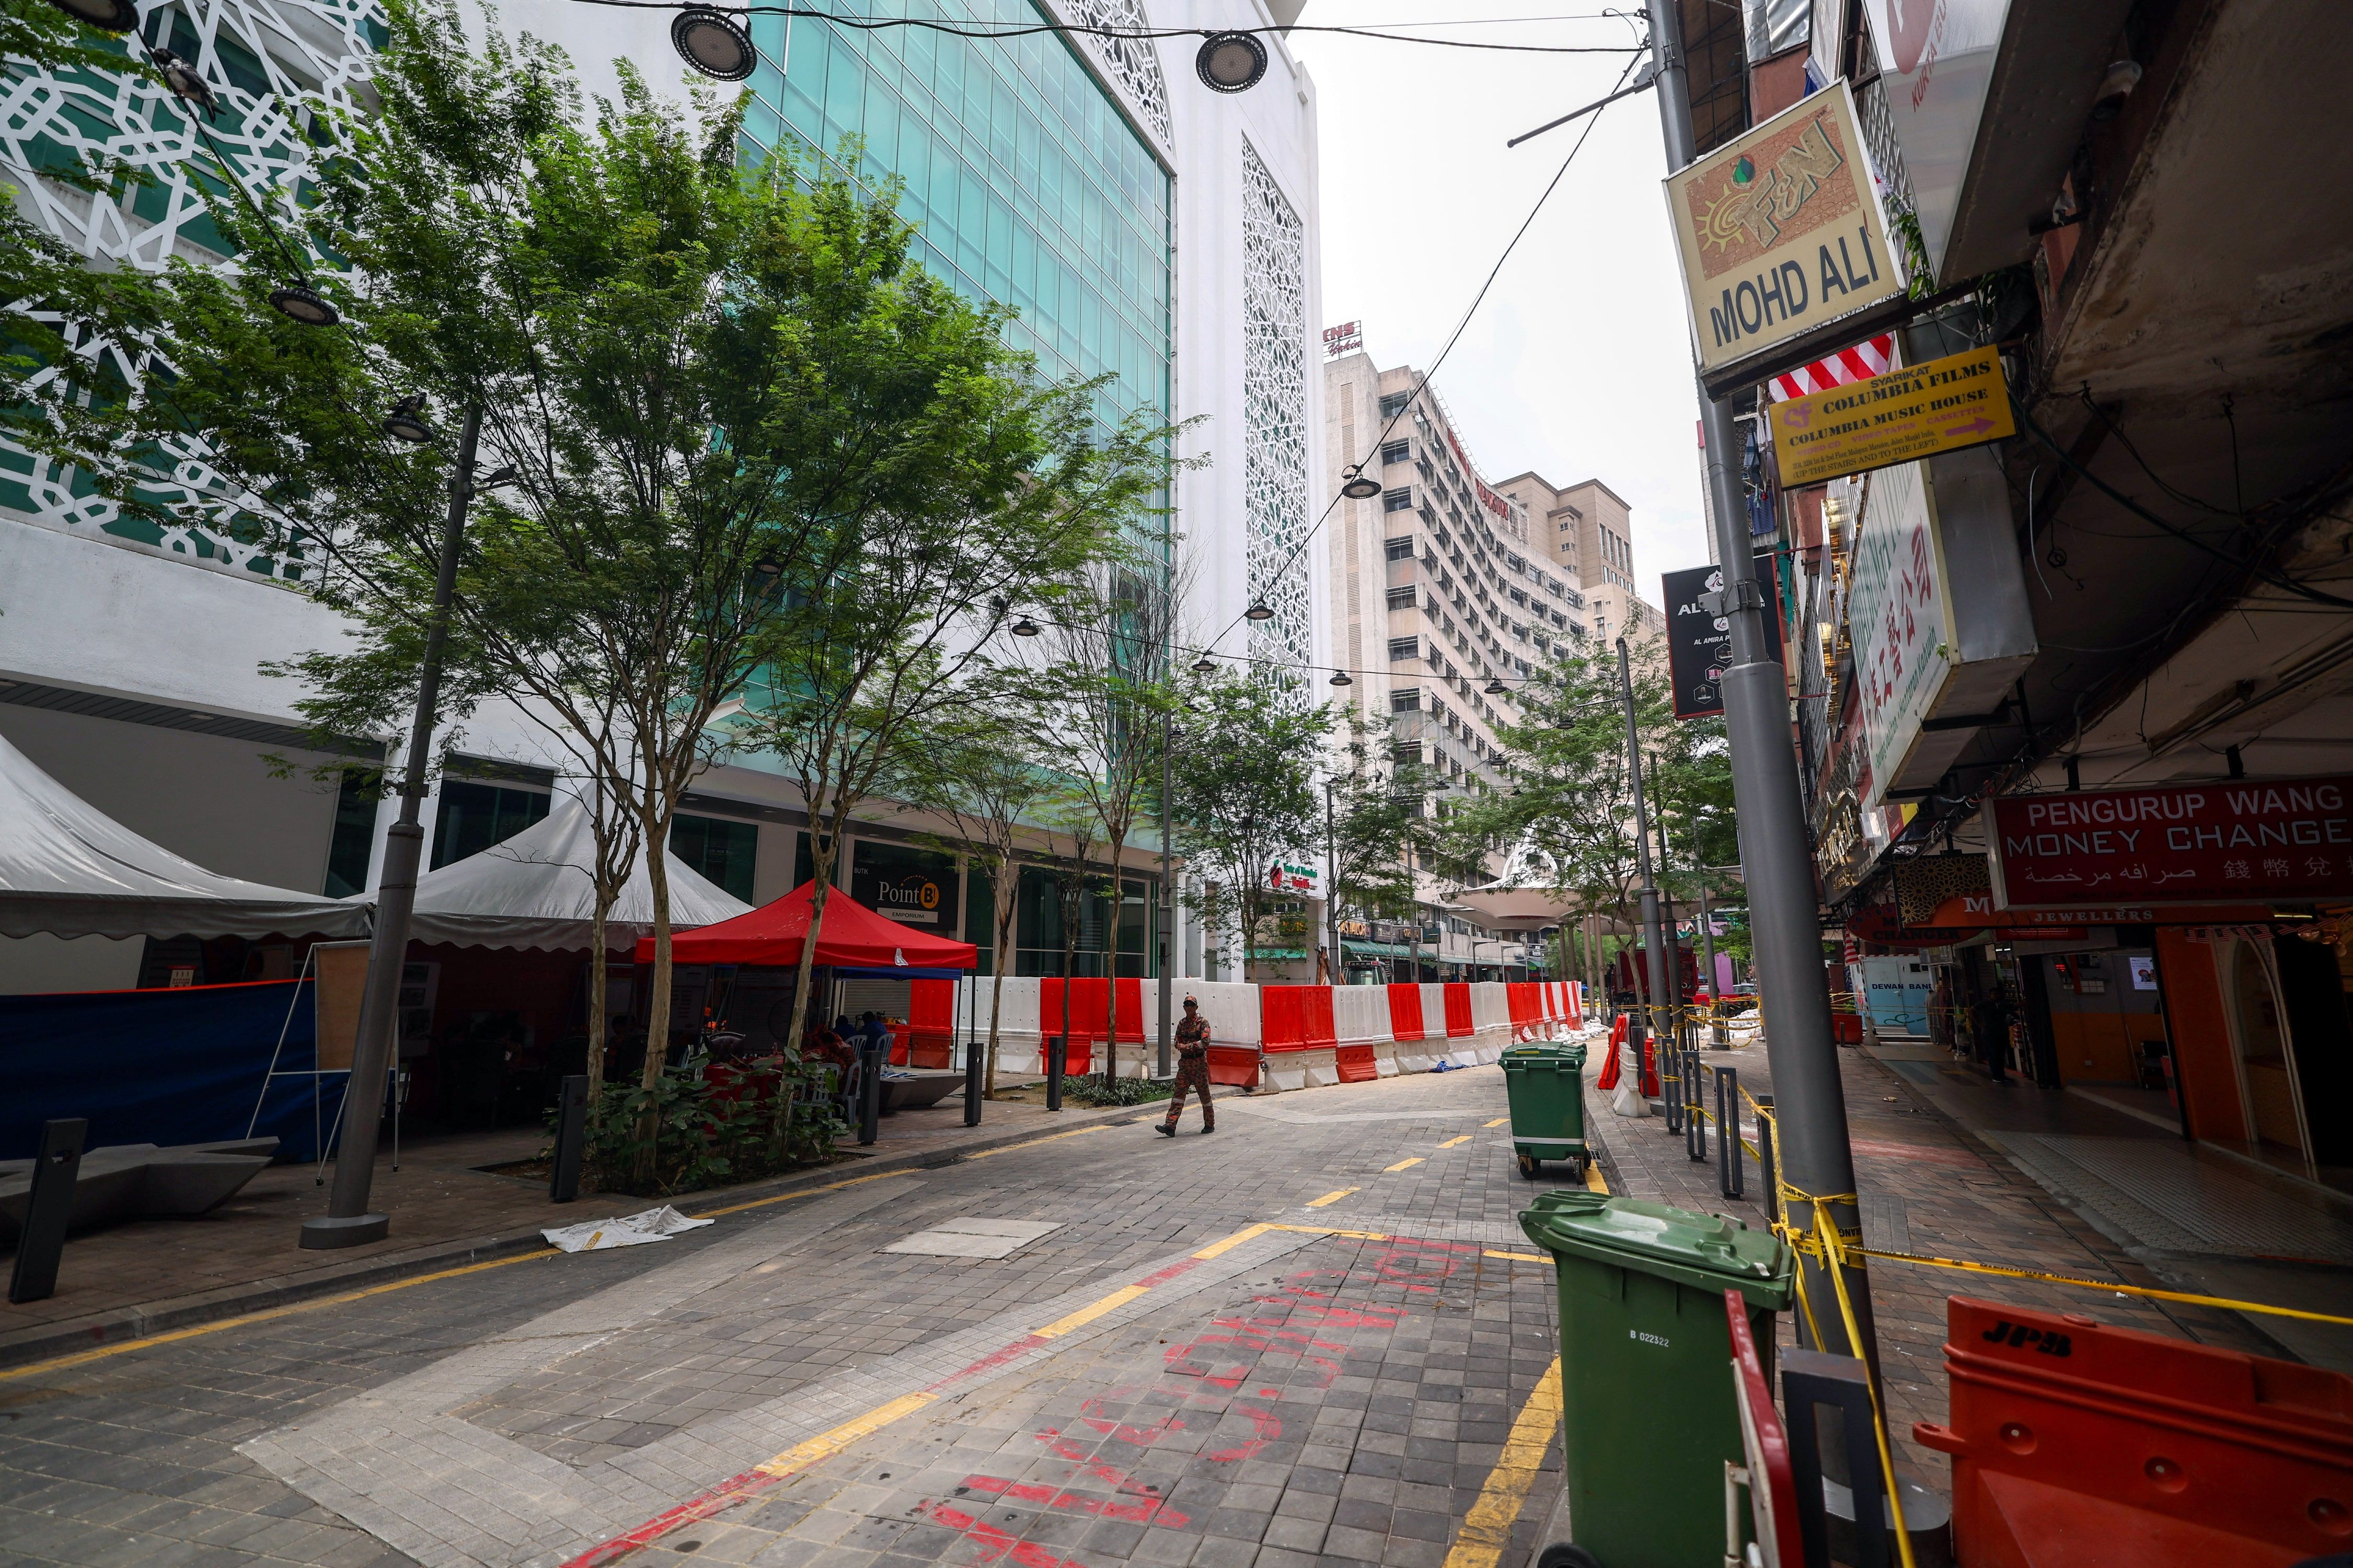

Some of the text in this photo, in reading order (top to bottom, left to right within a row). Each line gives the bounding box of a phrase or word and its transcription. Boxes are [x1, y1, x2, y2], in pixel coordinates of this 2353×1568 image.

[1912, 42, 1938, 113] KURTA
[1710, 260, 1809, 348] MOHD
[1820, 226, 1879, 304] ALI
[1823, 361, 1991, 415] COLUMBIA FILMS
[1871, 366, 1931, 388] SYARIKAT
[1790, 388, 1989, 447] COLUMBIA MUSIC HOUSE
[1797, 406, 1985, 456] VIDEO CD VIDEO TAPES CASSETTES
[1809, 466, 1827, 475] THE
[1828, 458, 1856, 470] STAIRS
[1859, 453, 1877, 463] AND
[1878, 449, 1891, 458] TO
[1892, 445, 1911, 455] THE
[1913, 438, 1939, 450] LEFT)
[1475, 478, 1508, 520] YAKIN
[1703, 636, 1723, 644] AMIRA
[1897, 662, 1920, 722] Hantaran
[1914, 618, 1939, 681] Kahwin
[2028, 785, 2343, 827] PENGURUP WANG
[2006, 828, 2140, 858] MONEY
[1283, 863, 1295, 874] Taste
[1295, 866, 1300, 875] of
[2223, 855, 2353, 879] 錢幣兌
[878, 881, 920, 904] Point
[1349, 922, 1366, 936] TAILOR
[2034, 909, 2154, 922] JEWELLERS
[1630, 1330, 1669, 1347] B 022322
